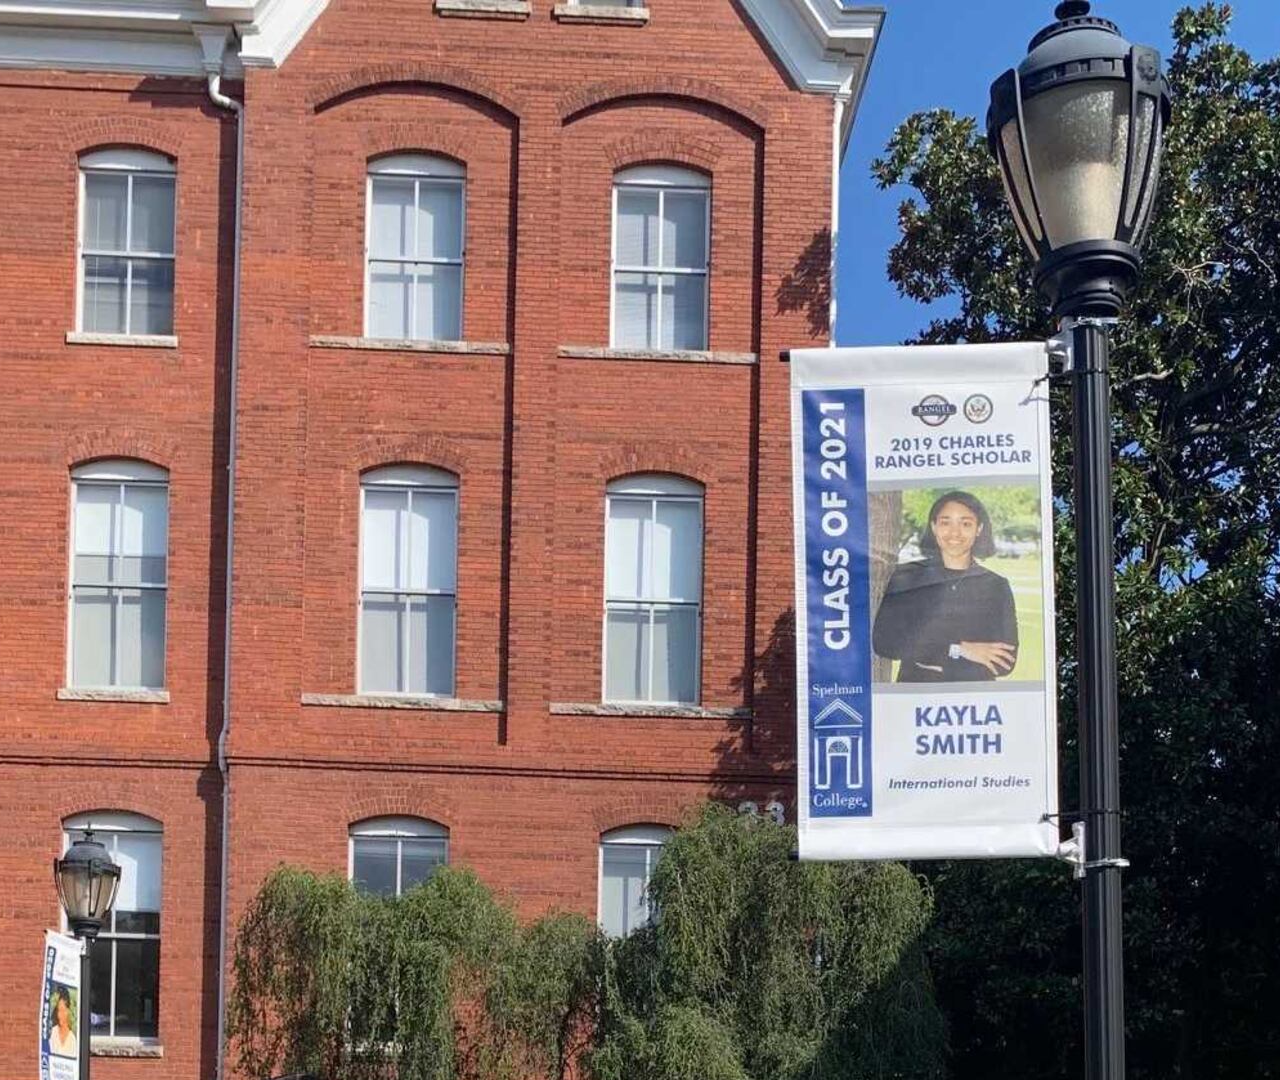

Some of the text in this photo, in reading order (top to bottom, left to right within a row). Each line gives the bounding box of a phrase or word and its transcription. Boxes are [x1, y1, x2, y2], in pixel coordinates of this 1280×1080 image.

[890, 433, 1015, 452] 2019 CHARLES
[875, 450, 1032, 469] RANGEL SCHOLAR
[819, 402, 851, 650] CLASS OF 2021
[812, 682, 864, 698] Spelman
[915, 704, 1003, 727] KAYLA
[915, 733, 1003, 756] SMITH
[888, 775, 1032, 790] International Studies
